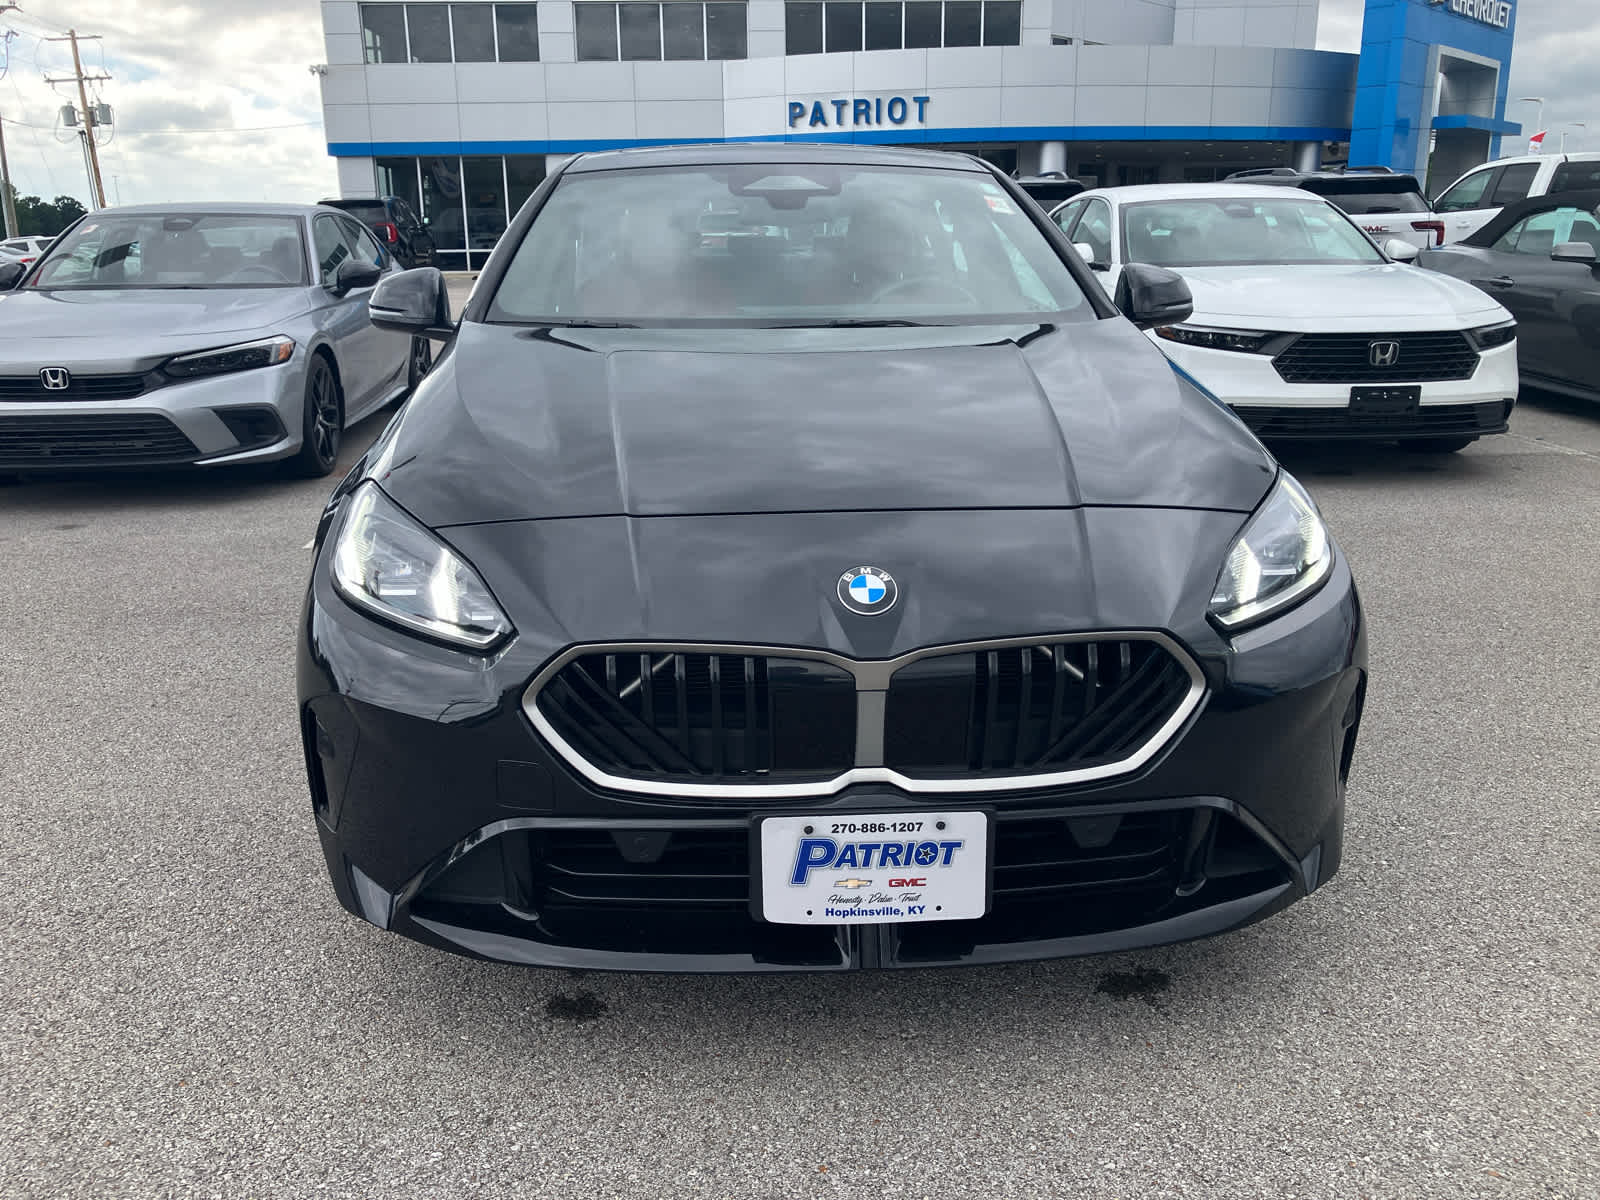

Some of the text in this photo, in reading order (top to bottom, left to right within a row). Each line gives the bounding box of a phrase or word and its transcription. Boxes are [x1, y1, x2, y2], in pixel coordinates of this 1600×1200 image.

[788, 95, 930, 128] PATRIOT
[842, 567, 891, 582] BMW
[831, 822, 924, 834] 270-886-1207
[790, 838, 963, 886] PATRIOT
[888, 878, 927, 887] GMC
[828, 894, 863, 907] Honesty
[898, 892, 922, 903] Trust
[825, 905, 925, 918] Hopkinsville, KY
